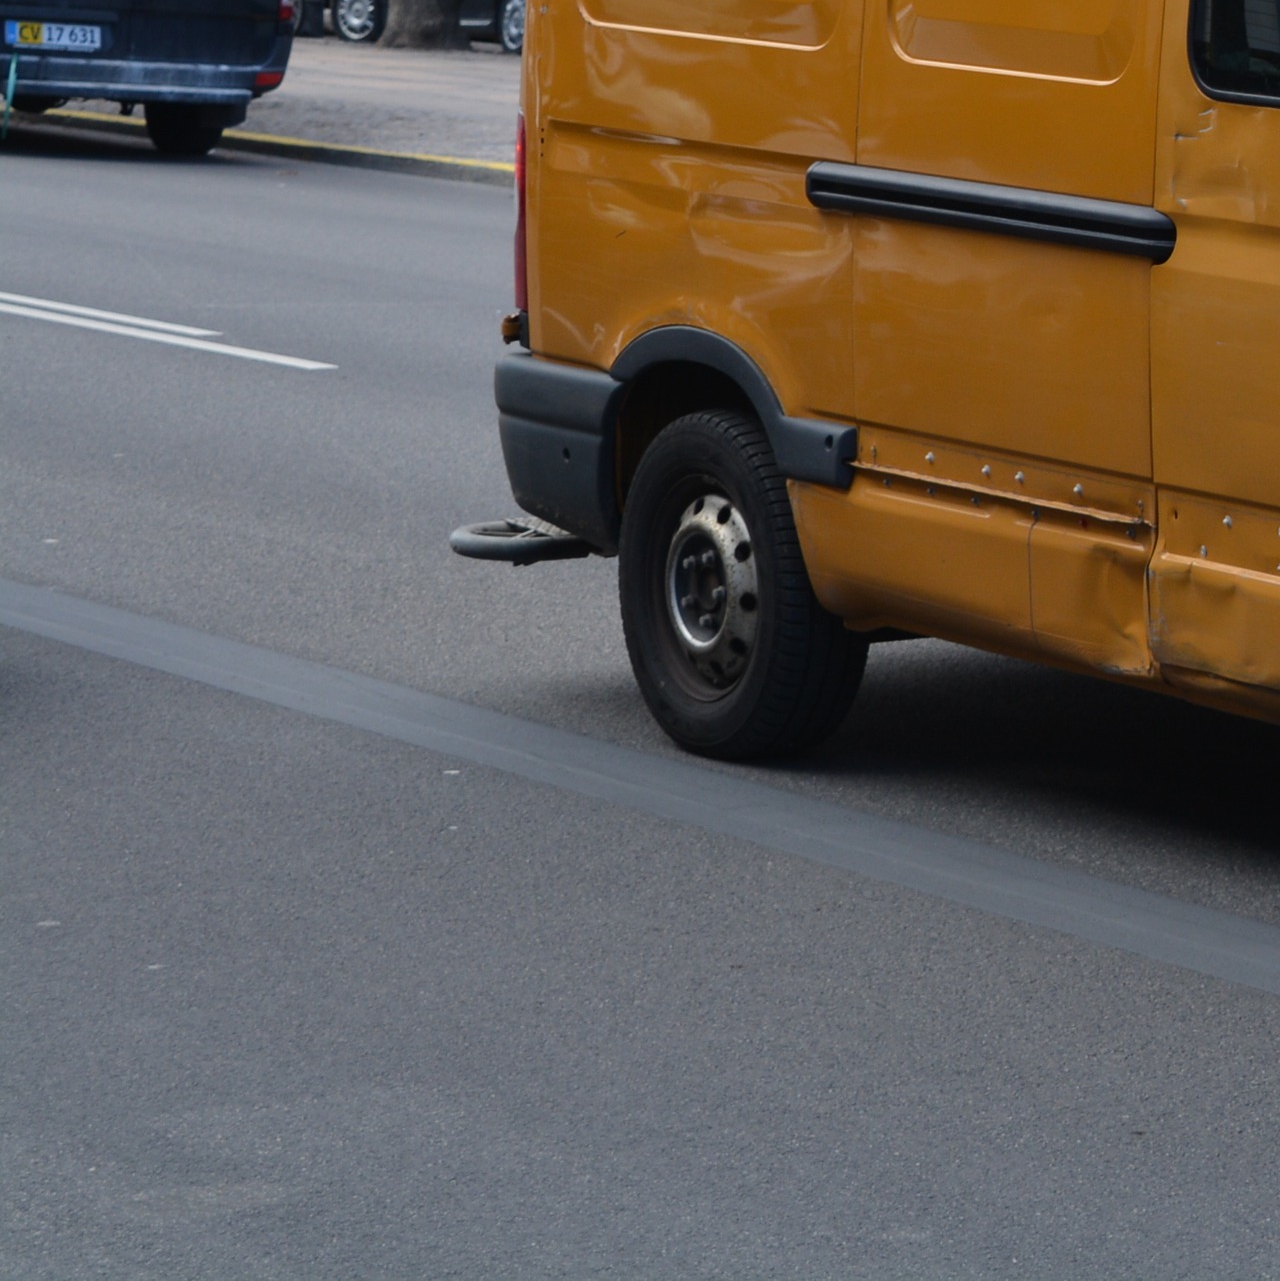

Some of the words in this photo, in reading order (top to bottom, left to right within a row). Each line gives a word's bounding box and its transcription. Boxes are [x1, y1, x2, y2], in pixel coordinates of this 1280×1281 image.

[19, 23, 42, 40] CV
[46, 25, 65, 42] 17
[68, 27, 97, 44] 631
